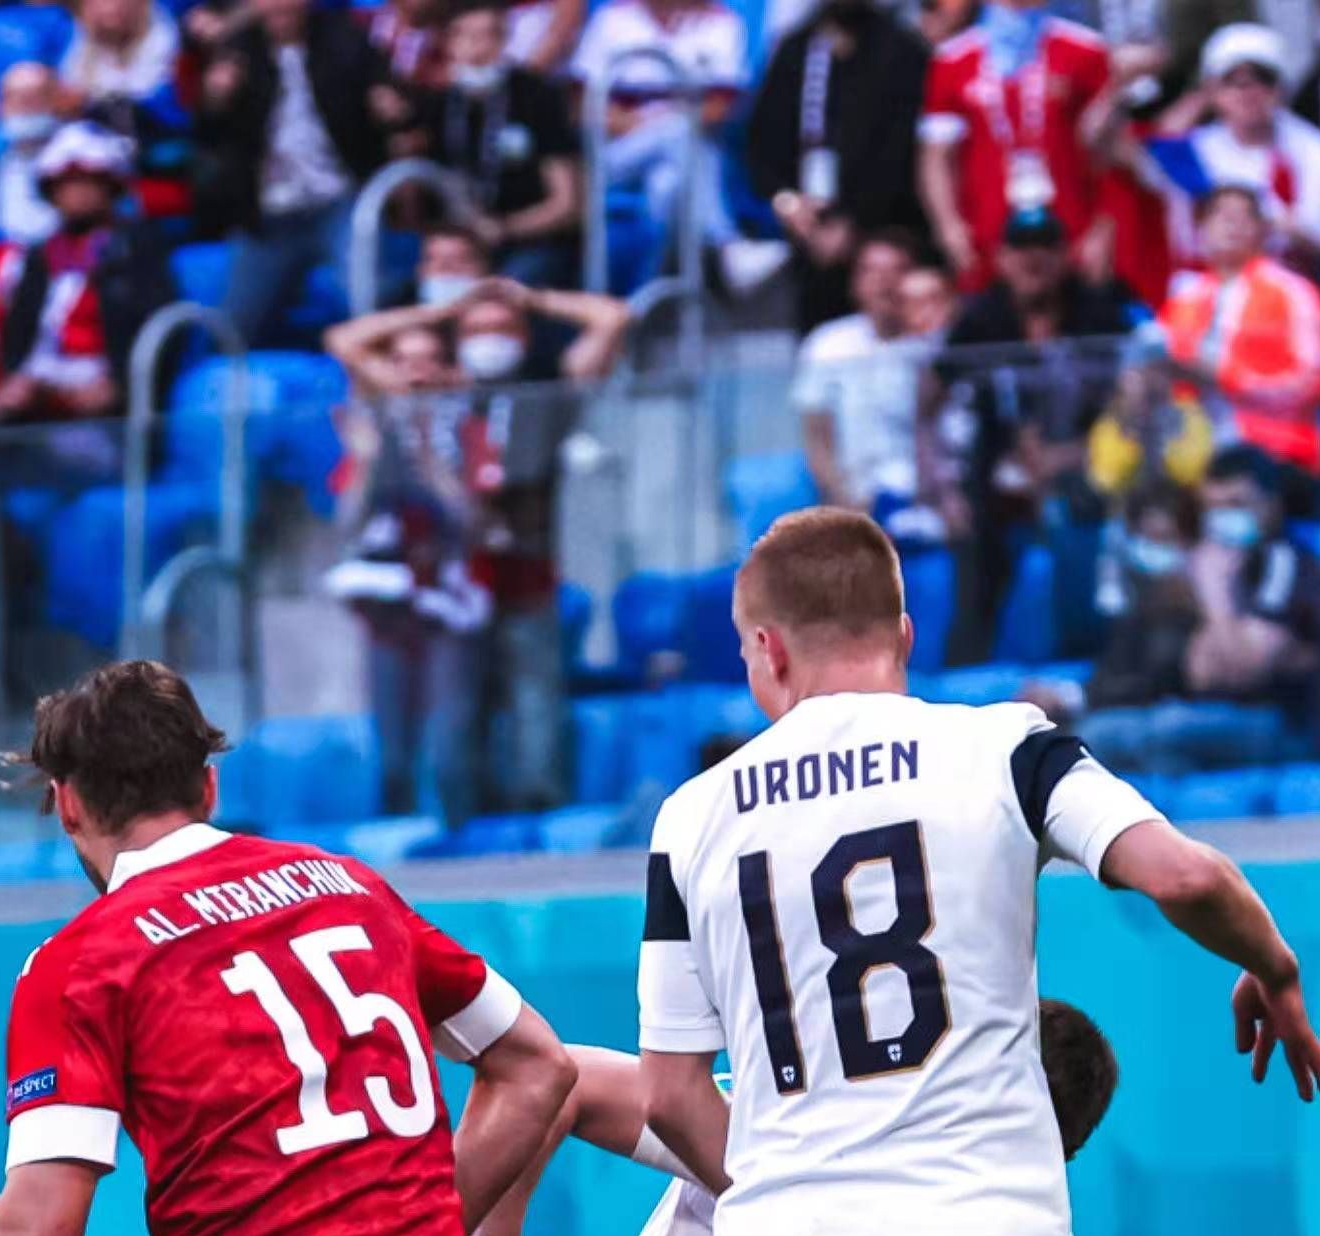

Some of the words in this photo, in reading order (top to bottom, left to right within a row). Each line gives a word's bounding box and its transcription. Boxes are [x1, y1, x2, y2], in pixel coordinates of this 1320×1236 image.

[733, 741, 919, 814] URONEN
[182, 859, 371, 925] MIRANCHUK
[737, 819, 953, 1096] 18
[220, 924, 437, 1155] 15
